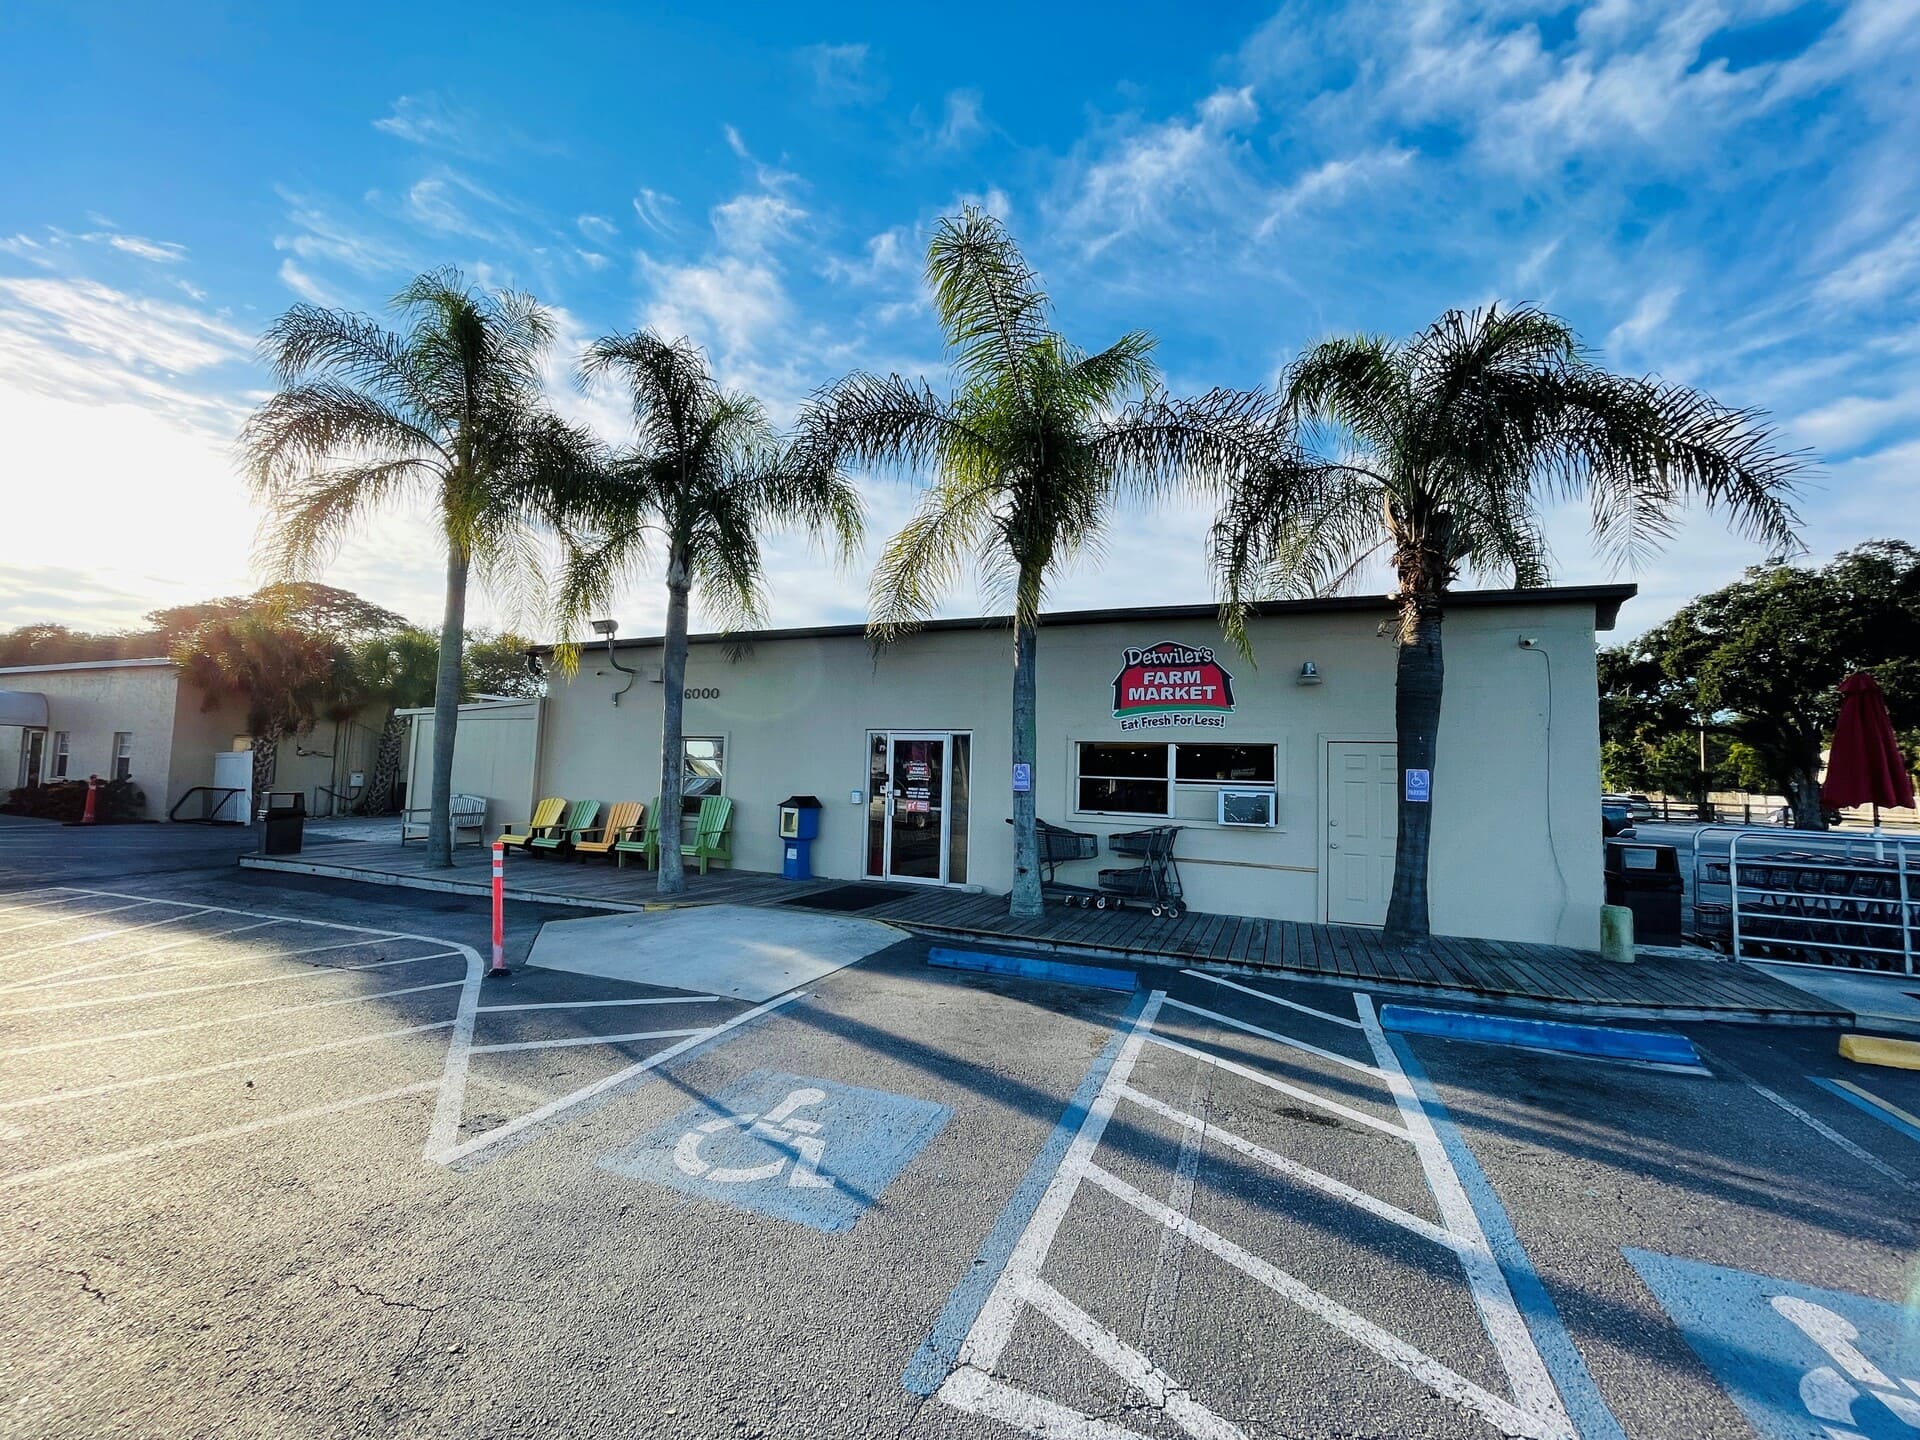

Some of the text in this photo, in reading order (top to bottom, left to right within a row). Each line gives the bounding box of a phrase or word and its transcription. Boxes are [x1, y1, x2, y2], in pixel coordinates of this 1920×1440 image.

[1128, 648, 1212, 665] Detwiler's
[1143, 670, 1201, 685] FARM
[684, 688, 720, 699] 6000
[1128, 685, 1216, 700] MARKET
[1121, 713, 1225, 731] Eat Fresh For Less!
